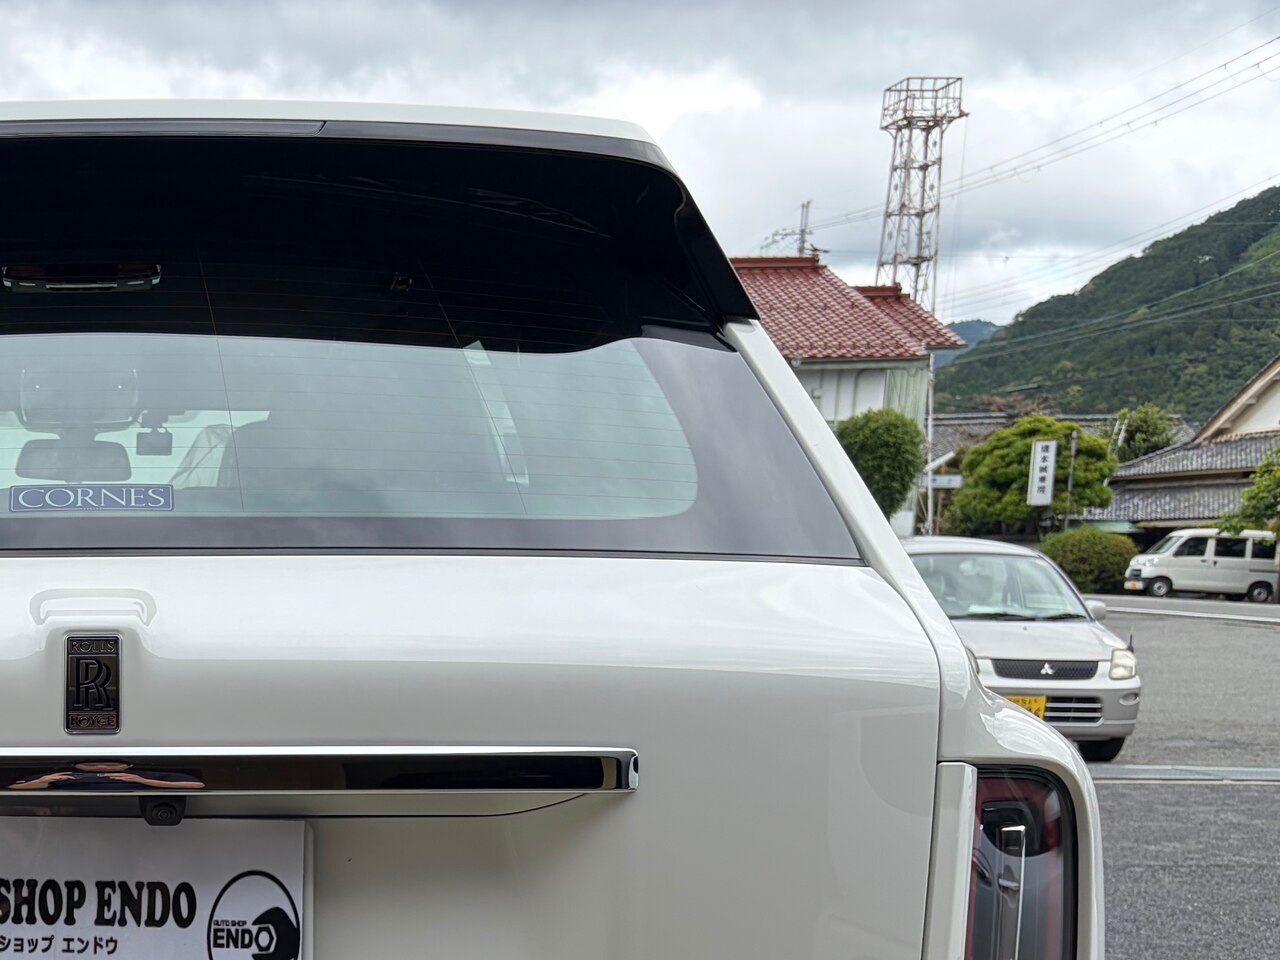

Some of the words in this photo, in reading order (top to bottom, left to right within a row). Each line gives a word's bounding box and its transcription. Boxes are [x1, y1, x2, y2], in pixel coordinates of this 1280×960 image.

[18, 487, 165, 508] CORNES
[71, 641, 116, 653] ROLLS
[70, 715, 116, 728] ROYCE
[94, 880, 197, 928] ENDO
[61, 935, 118, 956] エンドウ
[213, 927, 275, 952] ENDO
